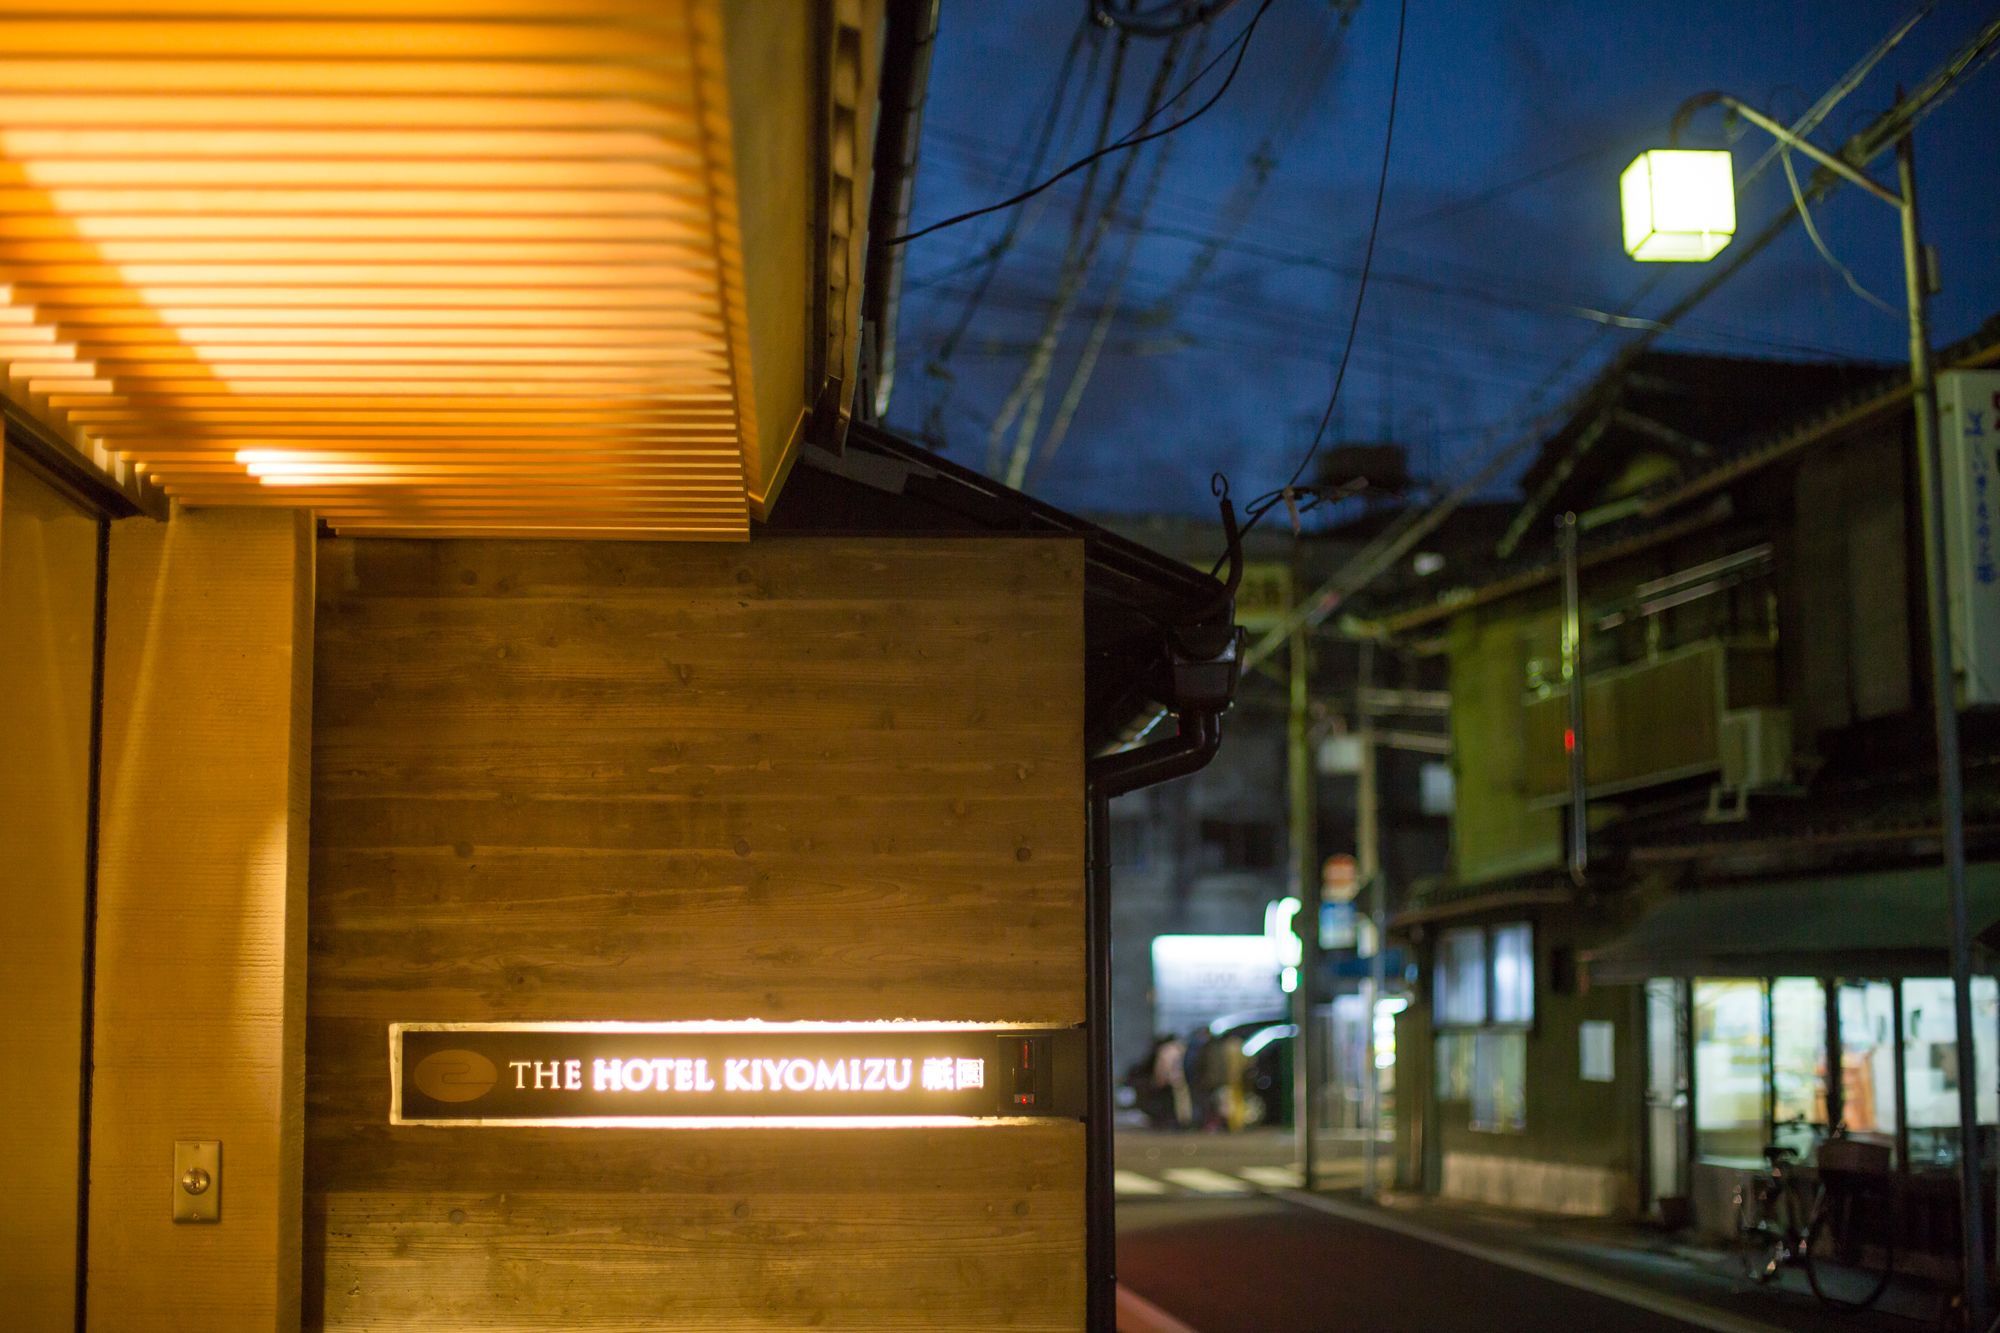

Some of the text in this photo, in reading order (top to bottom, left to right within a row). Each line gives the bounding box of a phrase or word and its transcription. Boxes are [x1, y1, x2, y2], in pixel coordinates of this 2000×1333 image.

[509, 1060, 582, 1090] THE
[592, 1057, 716, 1092] HOTEL
[723, 1057, 913, 1092] KIYOMIZU
